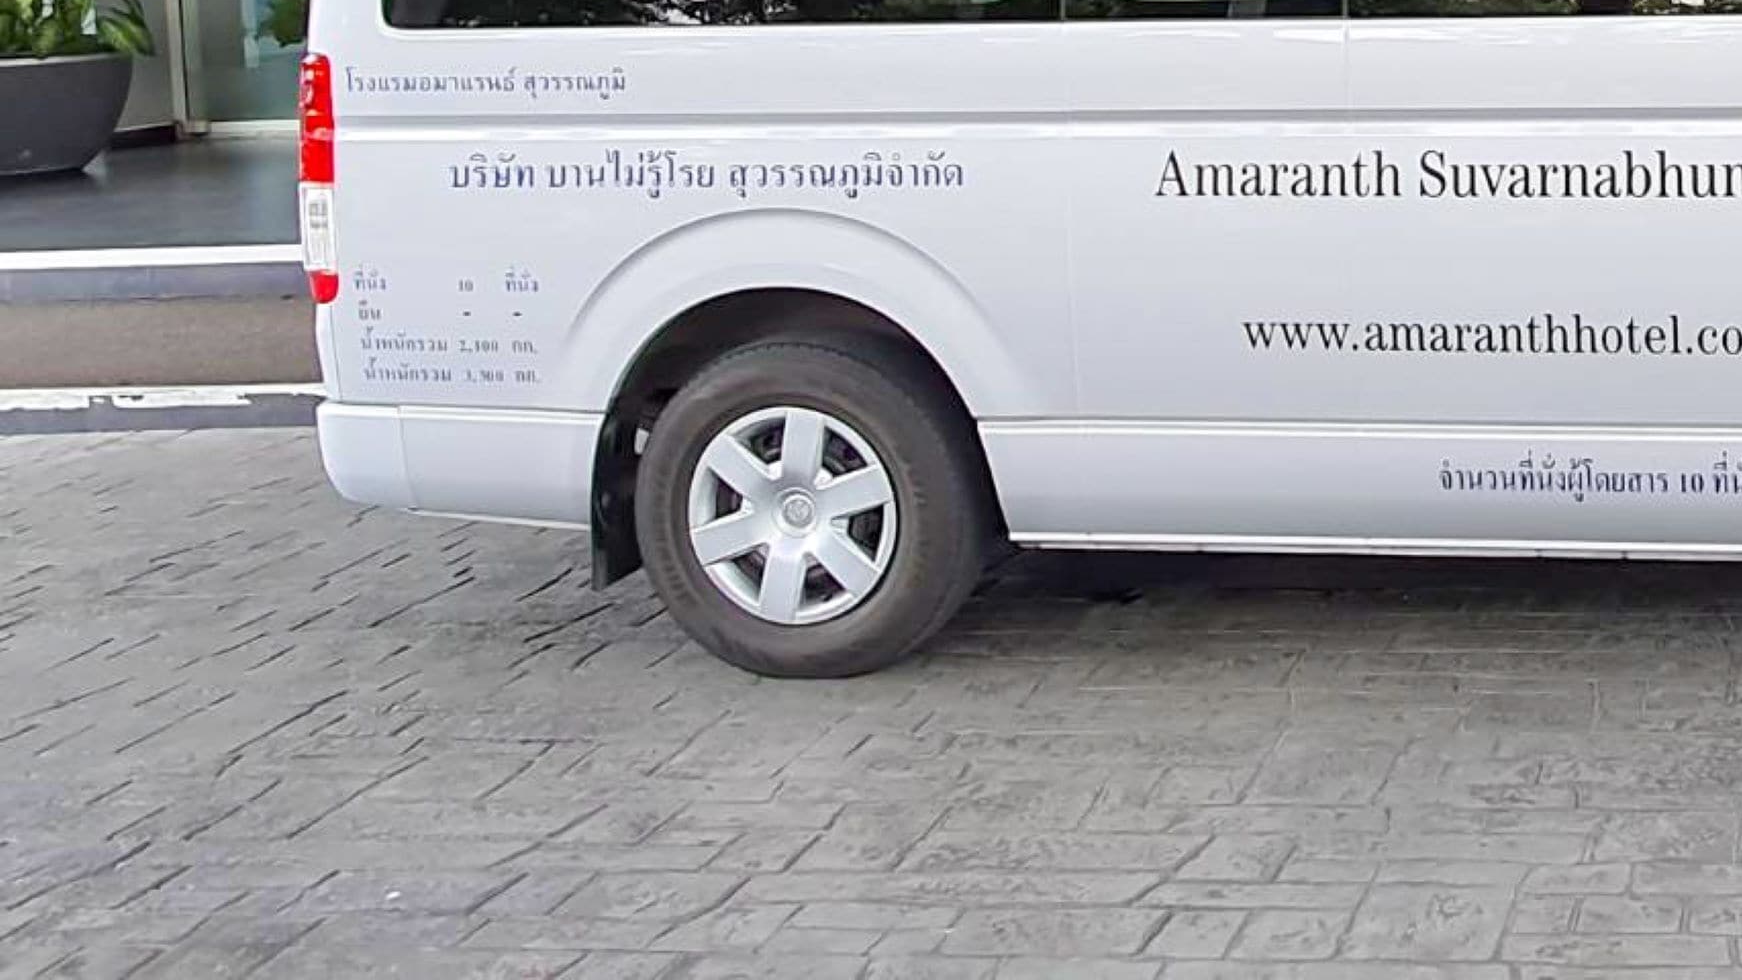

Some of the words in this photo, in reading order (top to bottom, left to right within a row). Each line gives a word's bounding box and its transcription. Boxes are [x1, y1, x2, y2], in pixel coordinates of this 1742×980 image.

[523, 66, 626, 101] สุวรรณภูมิ
[449, 153, 535, 189] บริษัท
[548, 149, 715, 199] บานไม่รู้โรย
[1155, 149, 1402, 198] Amaranth
[1439, 450, 1669, 503] จำนวนที่นั่งผู้โดยสาร
[1680, 472, 1705, 494] 10
